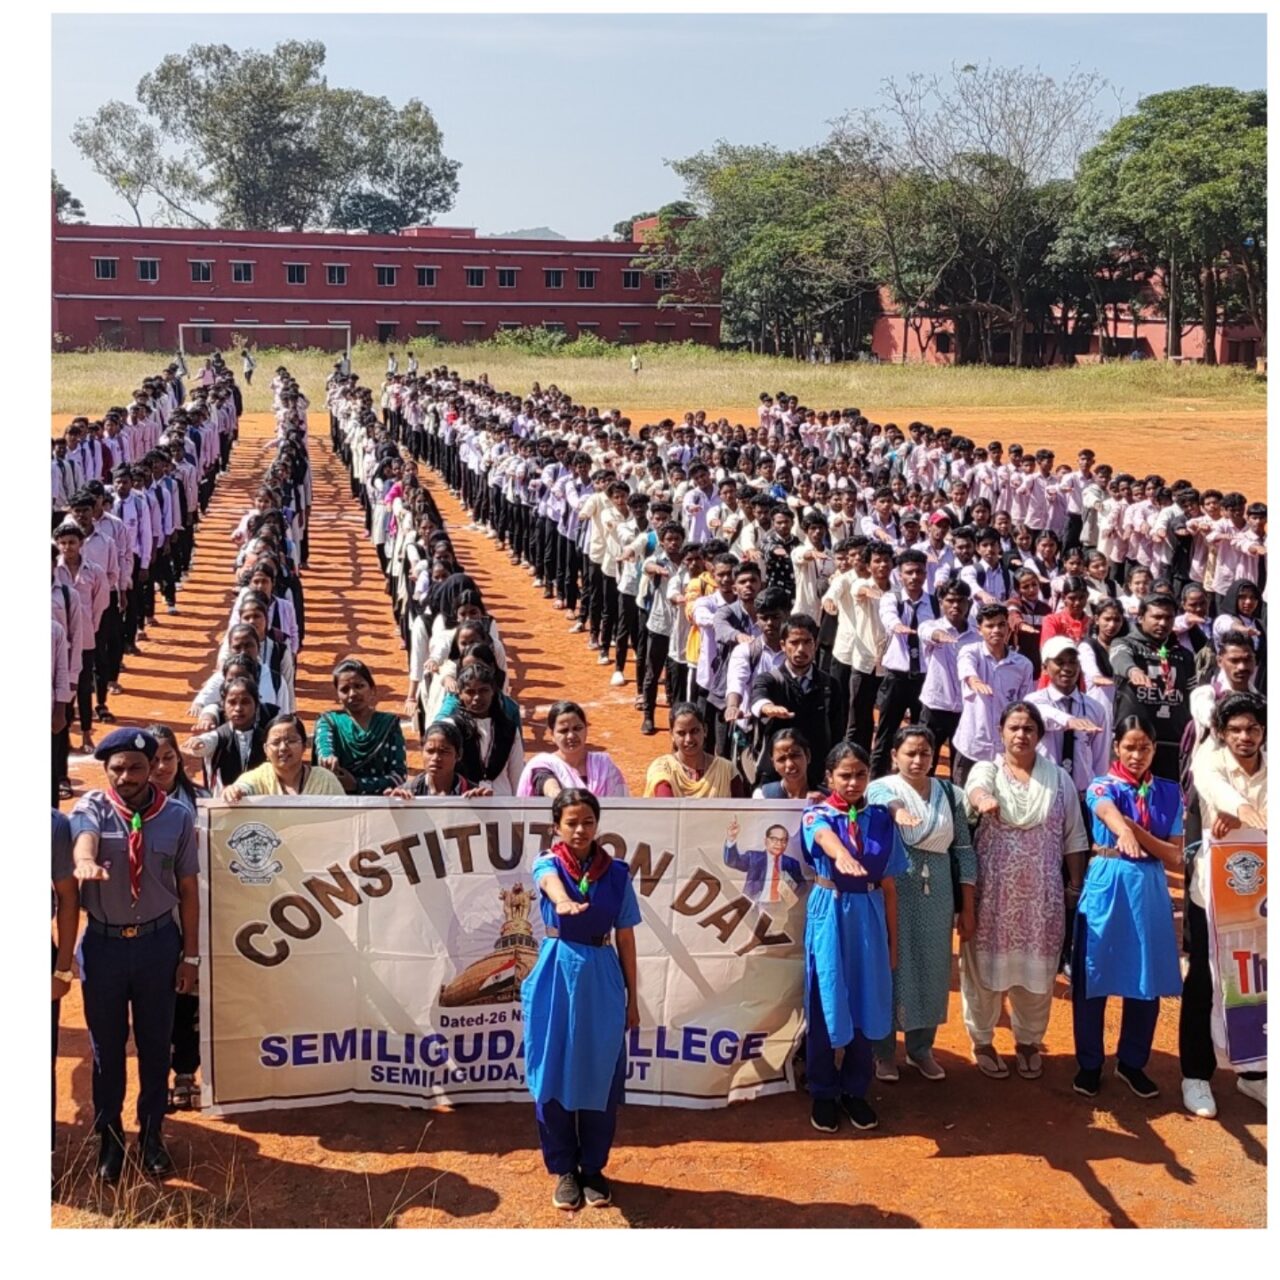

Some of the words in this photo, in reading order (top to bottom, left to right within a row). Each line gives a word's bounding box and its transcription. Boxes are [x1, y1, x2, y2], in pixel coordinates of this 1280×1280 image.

[1136, 686, 1184, 702] SEVEN
[234, 821, 674, 968] CONSTITUTON
[670, 866, 794, 959] DAY
[1233, 951, 1267, 995] Th
[440, 1010, 507, 1029] Dated-26
[629, 1025, 769, 1066] LLEGE
